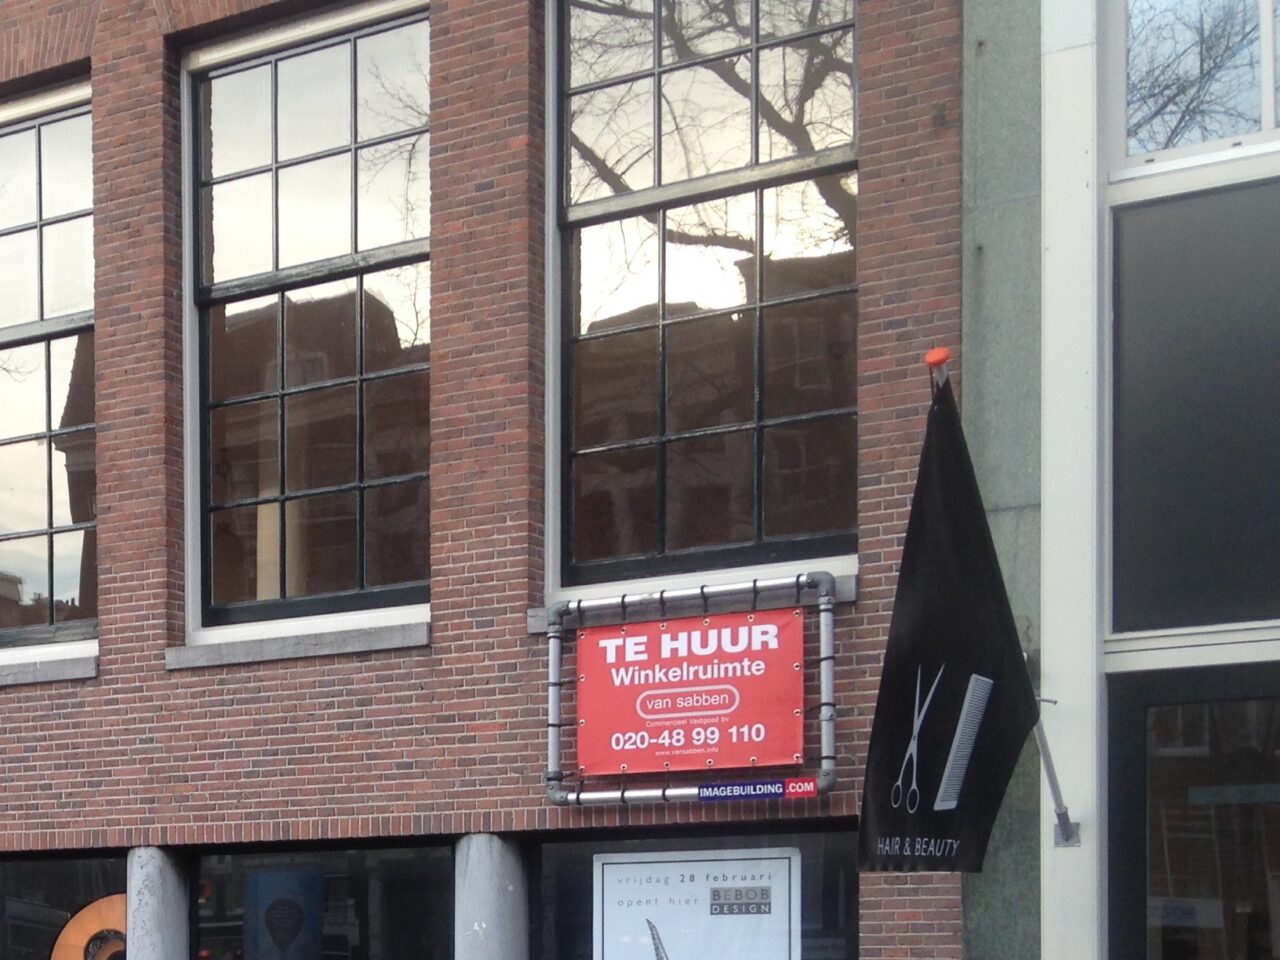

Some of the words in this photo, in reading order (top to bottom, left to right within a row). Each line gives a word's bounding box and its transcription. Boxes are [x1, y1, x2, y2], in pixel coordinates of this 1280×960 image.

[599, 636, 648, 664] TE
[661, 624, 779, 659] HUUR
[611, 658, 766, 687] Winkelruimte
[646, 697, 672, 710] van
[676, 692, 729, 708] sabben
[646, 718, 688, 728] Commercieel
[689, 716, 719, 725] Vastgoed
[611, 729, 685, 750] 020-48
[692, 726, 720, 745] 99
[728, 723, 765, 743] 110
[877, 837, 900, 855] HAIR
[903, 837, 911, 855] &
[914, 838, 960, 856] BEAUTY
[617, 875, 670, 886] vrijdag
[679, 873, 696, 883] 28
[705, 872, 772, 882] februari
[617, 898, 659, 908] opent
[668, 897, 698, 906] hier
[712, 889, 770, 901] BEBOB
[712, 903, 770, 914] DESIGN
